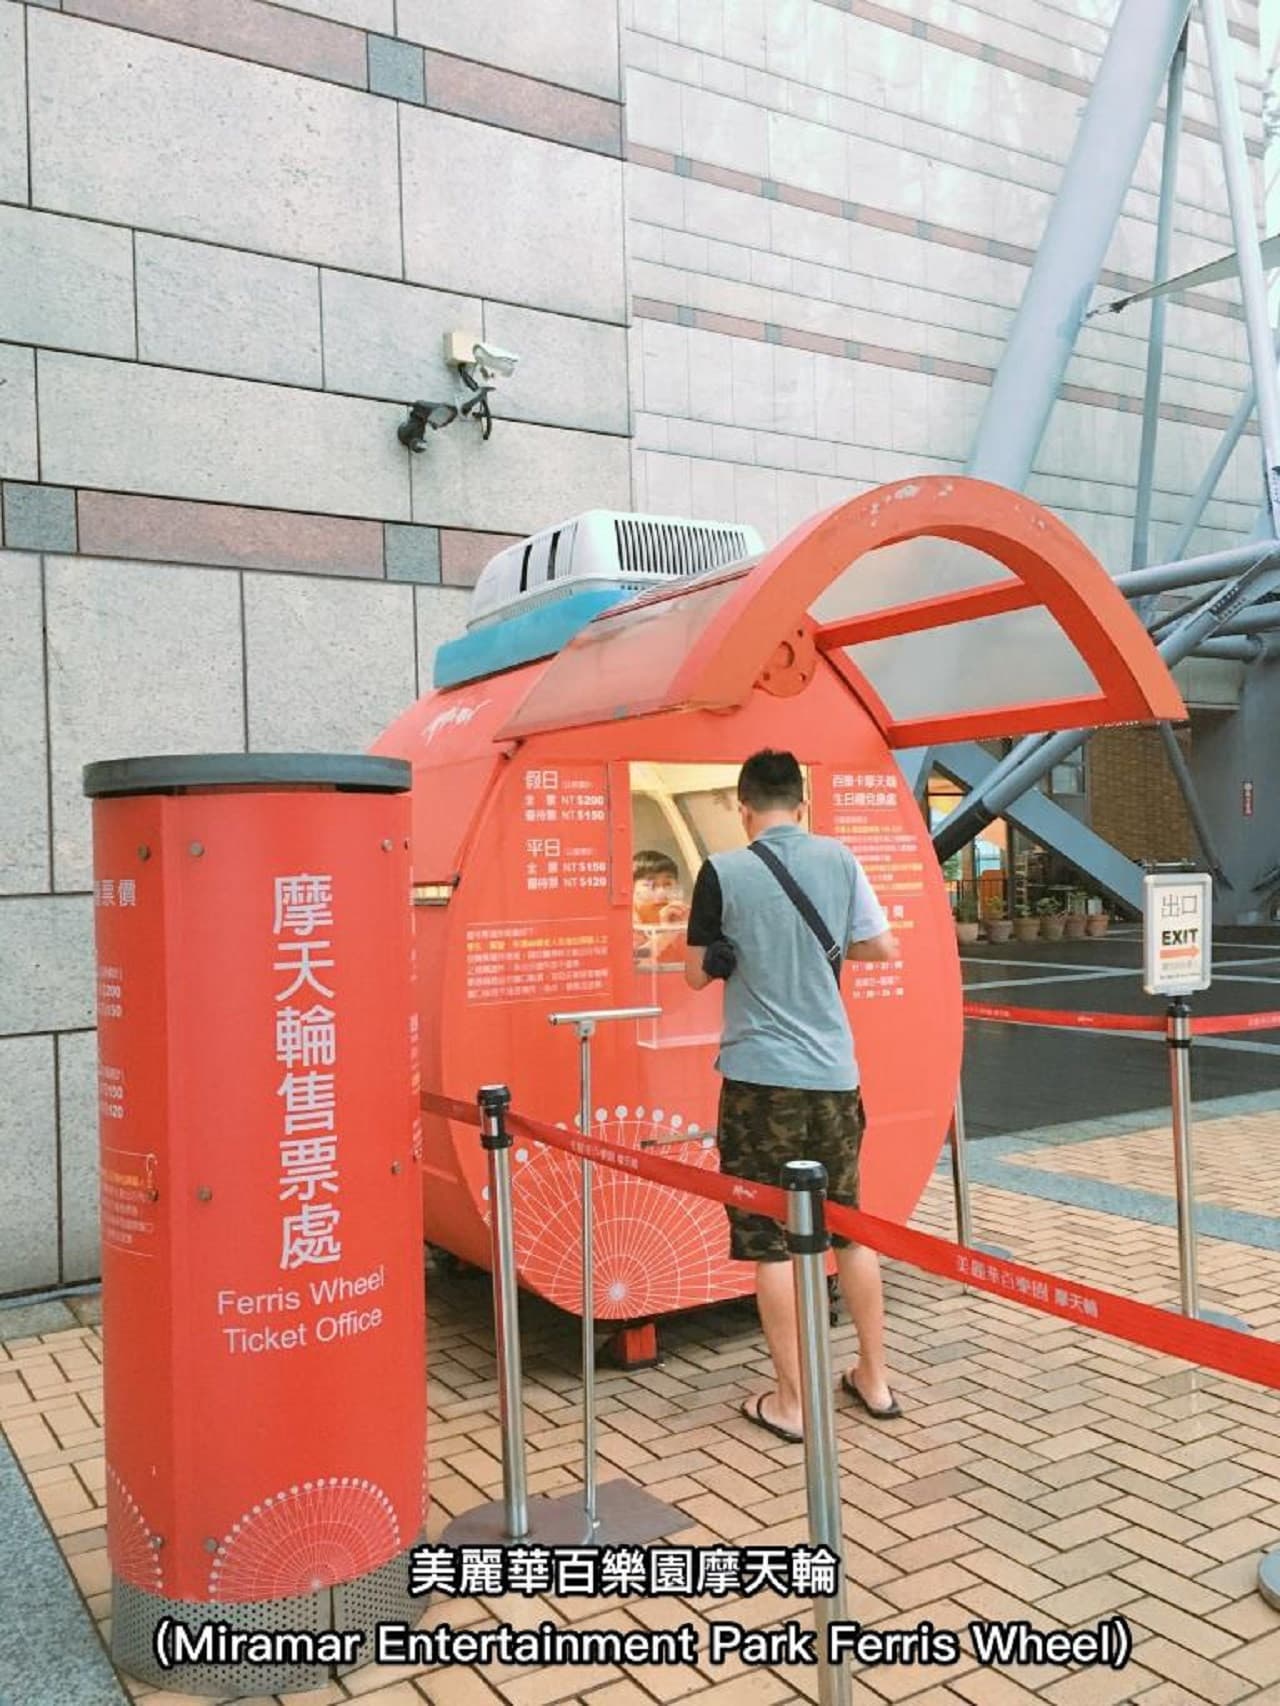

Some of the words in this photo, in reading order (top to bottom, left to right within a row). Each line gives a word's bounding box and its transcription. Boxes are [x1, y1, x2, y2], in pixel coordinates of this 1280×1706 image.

[527, 838, 560, 857] 平日
[1161, 893, 1198, 917] 出口
[1161, 928, 1198, 946] EXIT
[273, 873, 341, 1270] 摩天輪售票處
[217, 1287, 301, 1316] Ferris
[309, 1264, 385, 1306] Wheel
[222, 1322, 307, 1354] Ticket
[315, 1307, 382, 1342] Office
